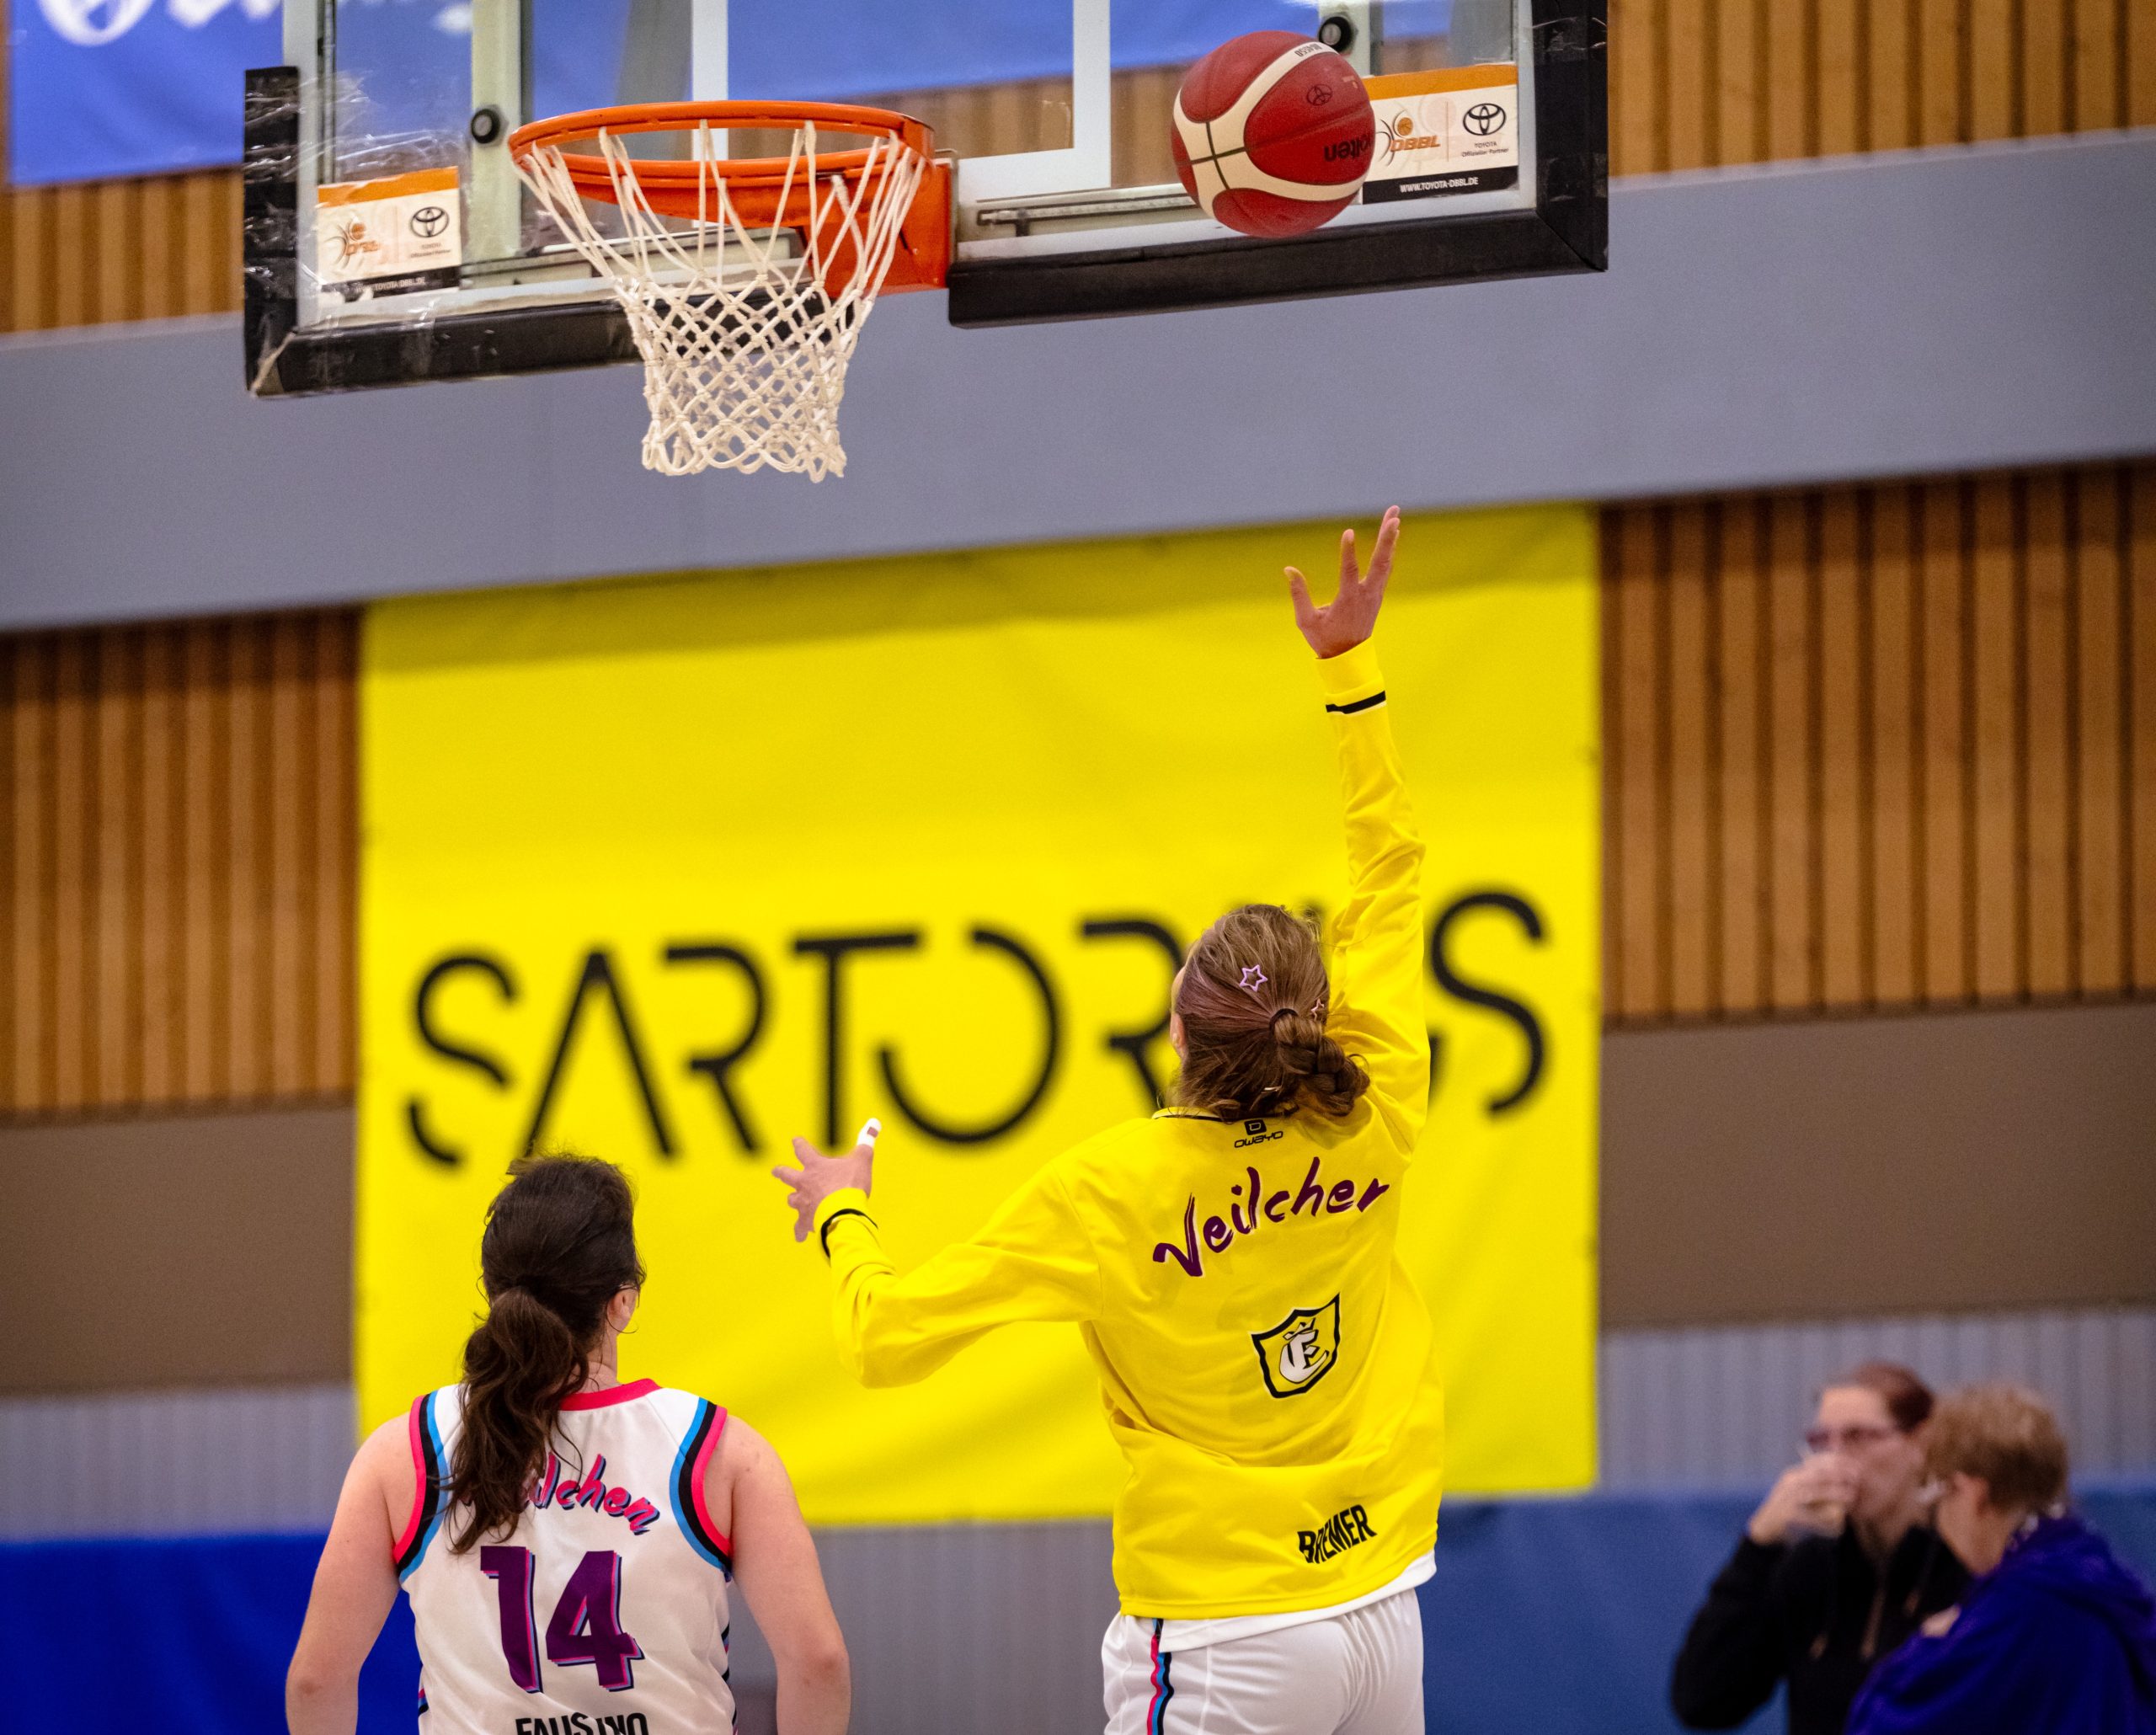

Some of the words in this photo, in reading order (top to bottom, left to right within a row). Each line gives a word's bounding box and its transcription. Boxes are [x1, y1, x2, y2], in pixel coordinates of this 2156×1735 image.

[1390, 135, 1441, 152] DBBL
[404, 891, 1546, 1165] SARTORS
[1234, 1131, 1283, 1148] owayo
[1297, 1504, 1378, 1564] BREMER
[480, 1545, 645, 1694] 14
